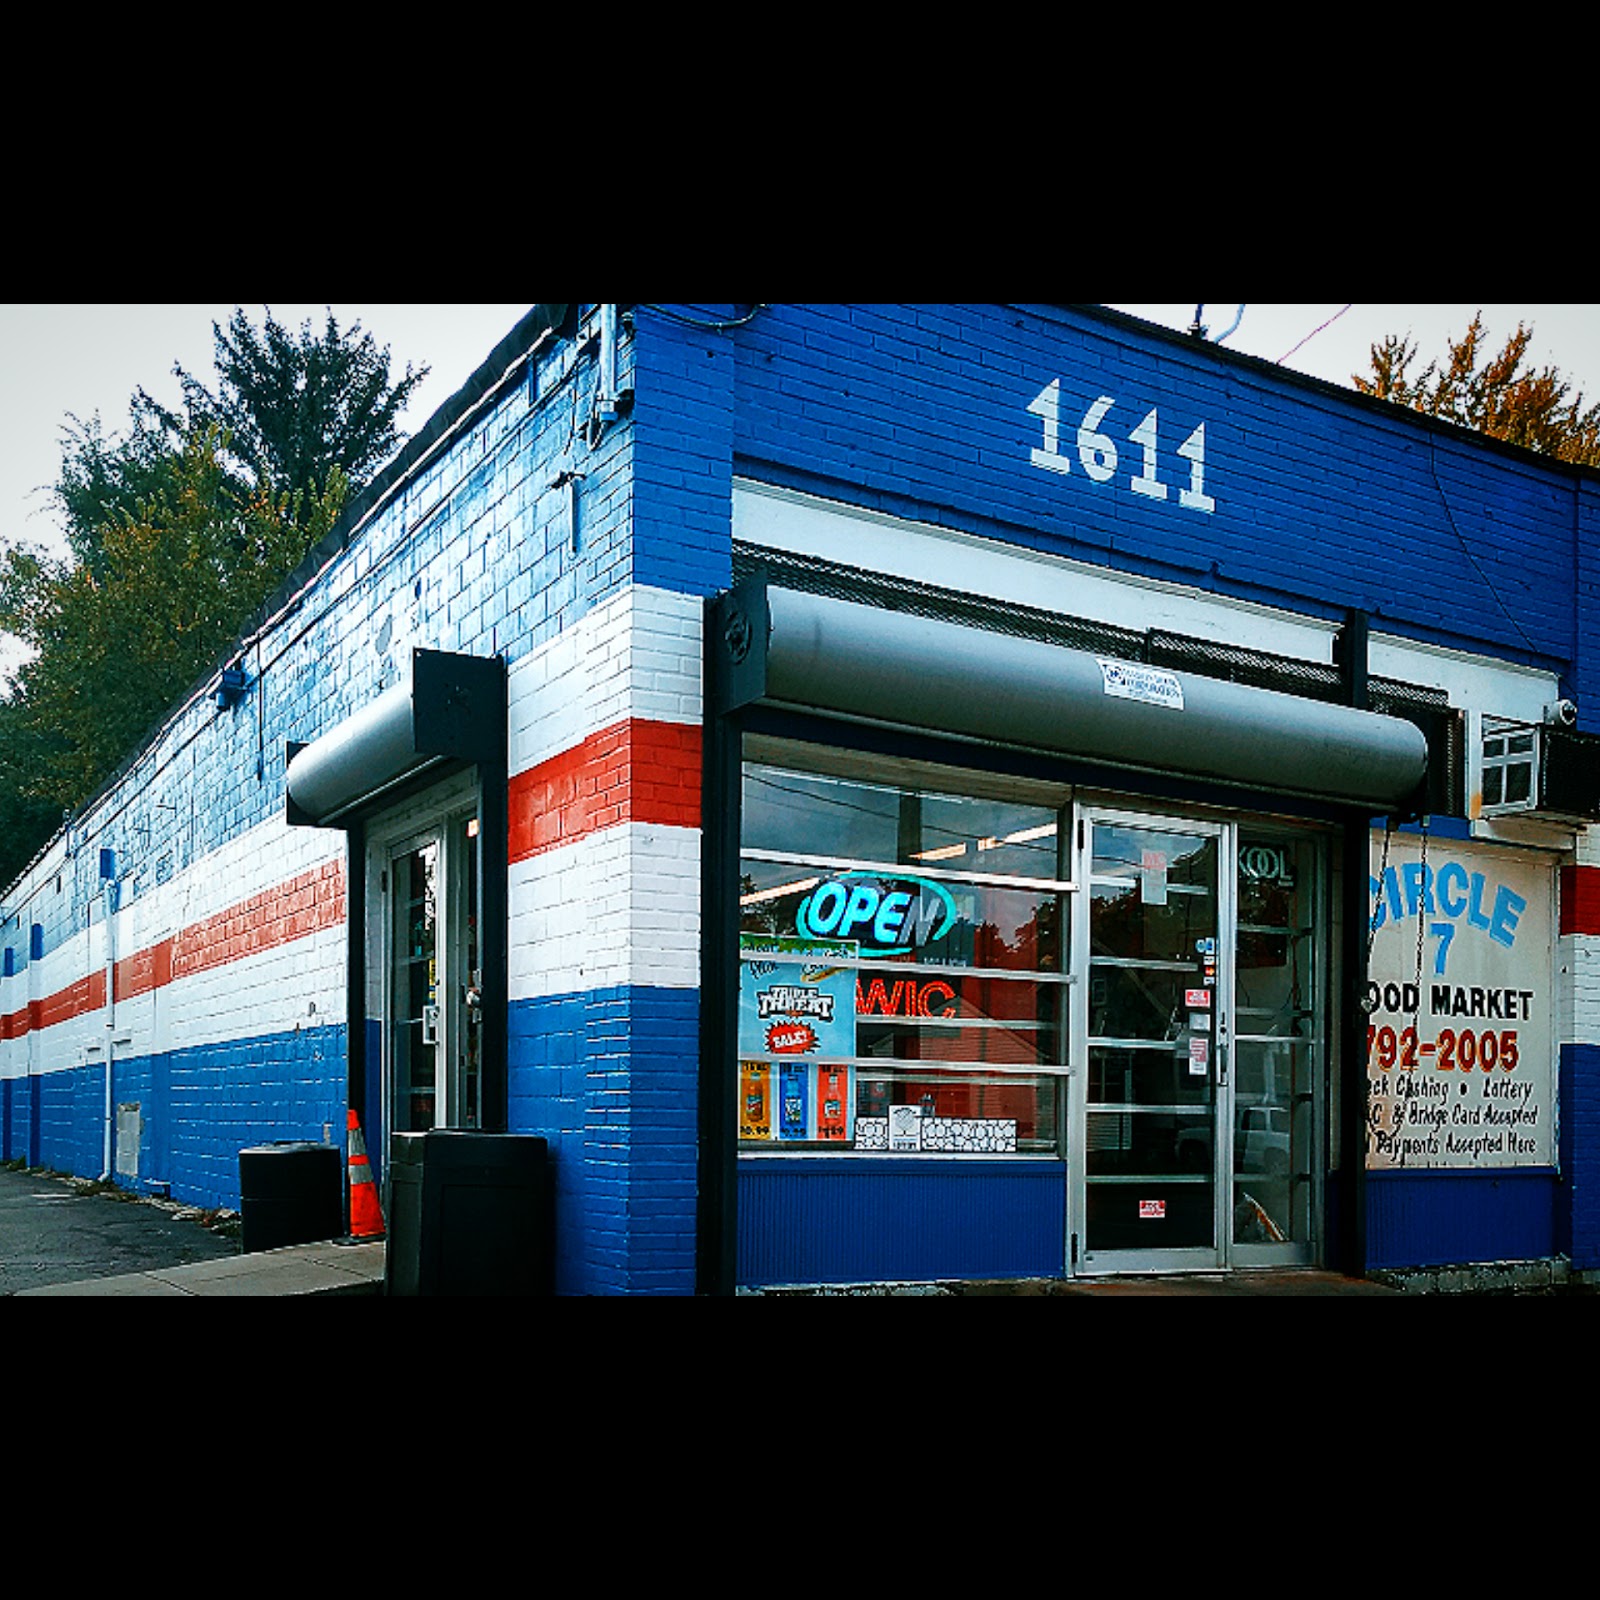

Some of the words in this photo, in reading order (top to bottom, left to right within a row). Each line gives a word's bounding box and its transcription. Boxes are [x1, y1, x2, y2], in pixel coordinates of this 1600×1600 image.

[1026, 378, 1215, 513] 1611
[808, 881, 942, 946] OPEN
[1429, 923, 1455, 976] 7
[759, 994, 832, 1018] THREAT
[856, 978, 956, 1018] WIC
[1368, 981, 1419, 1013] OOD
[1431, 985, 1533, 1021] MARKET
[1483, 1077, 1533, 1107] Lottery
[1409, 1102, 1448, 1133] Bridge
[1452, 1103, 1481, 1125] Card
[1484, 1103, 1538, 1128] Accepted
[1376, 1131, 1440, 1165] Payments
[1446, 1132, 1503, 1160] Accepted
[1506, 1131, 1536, 1153] Here
